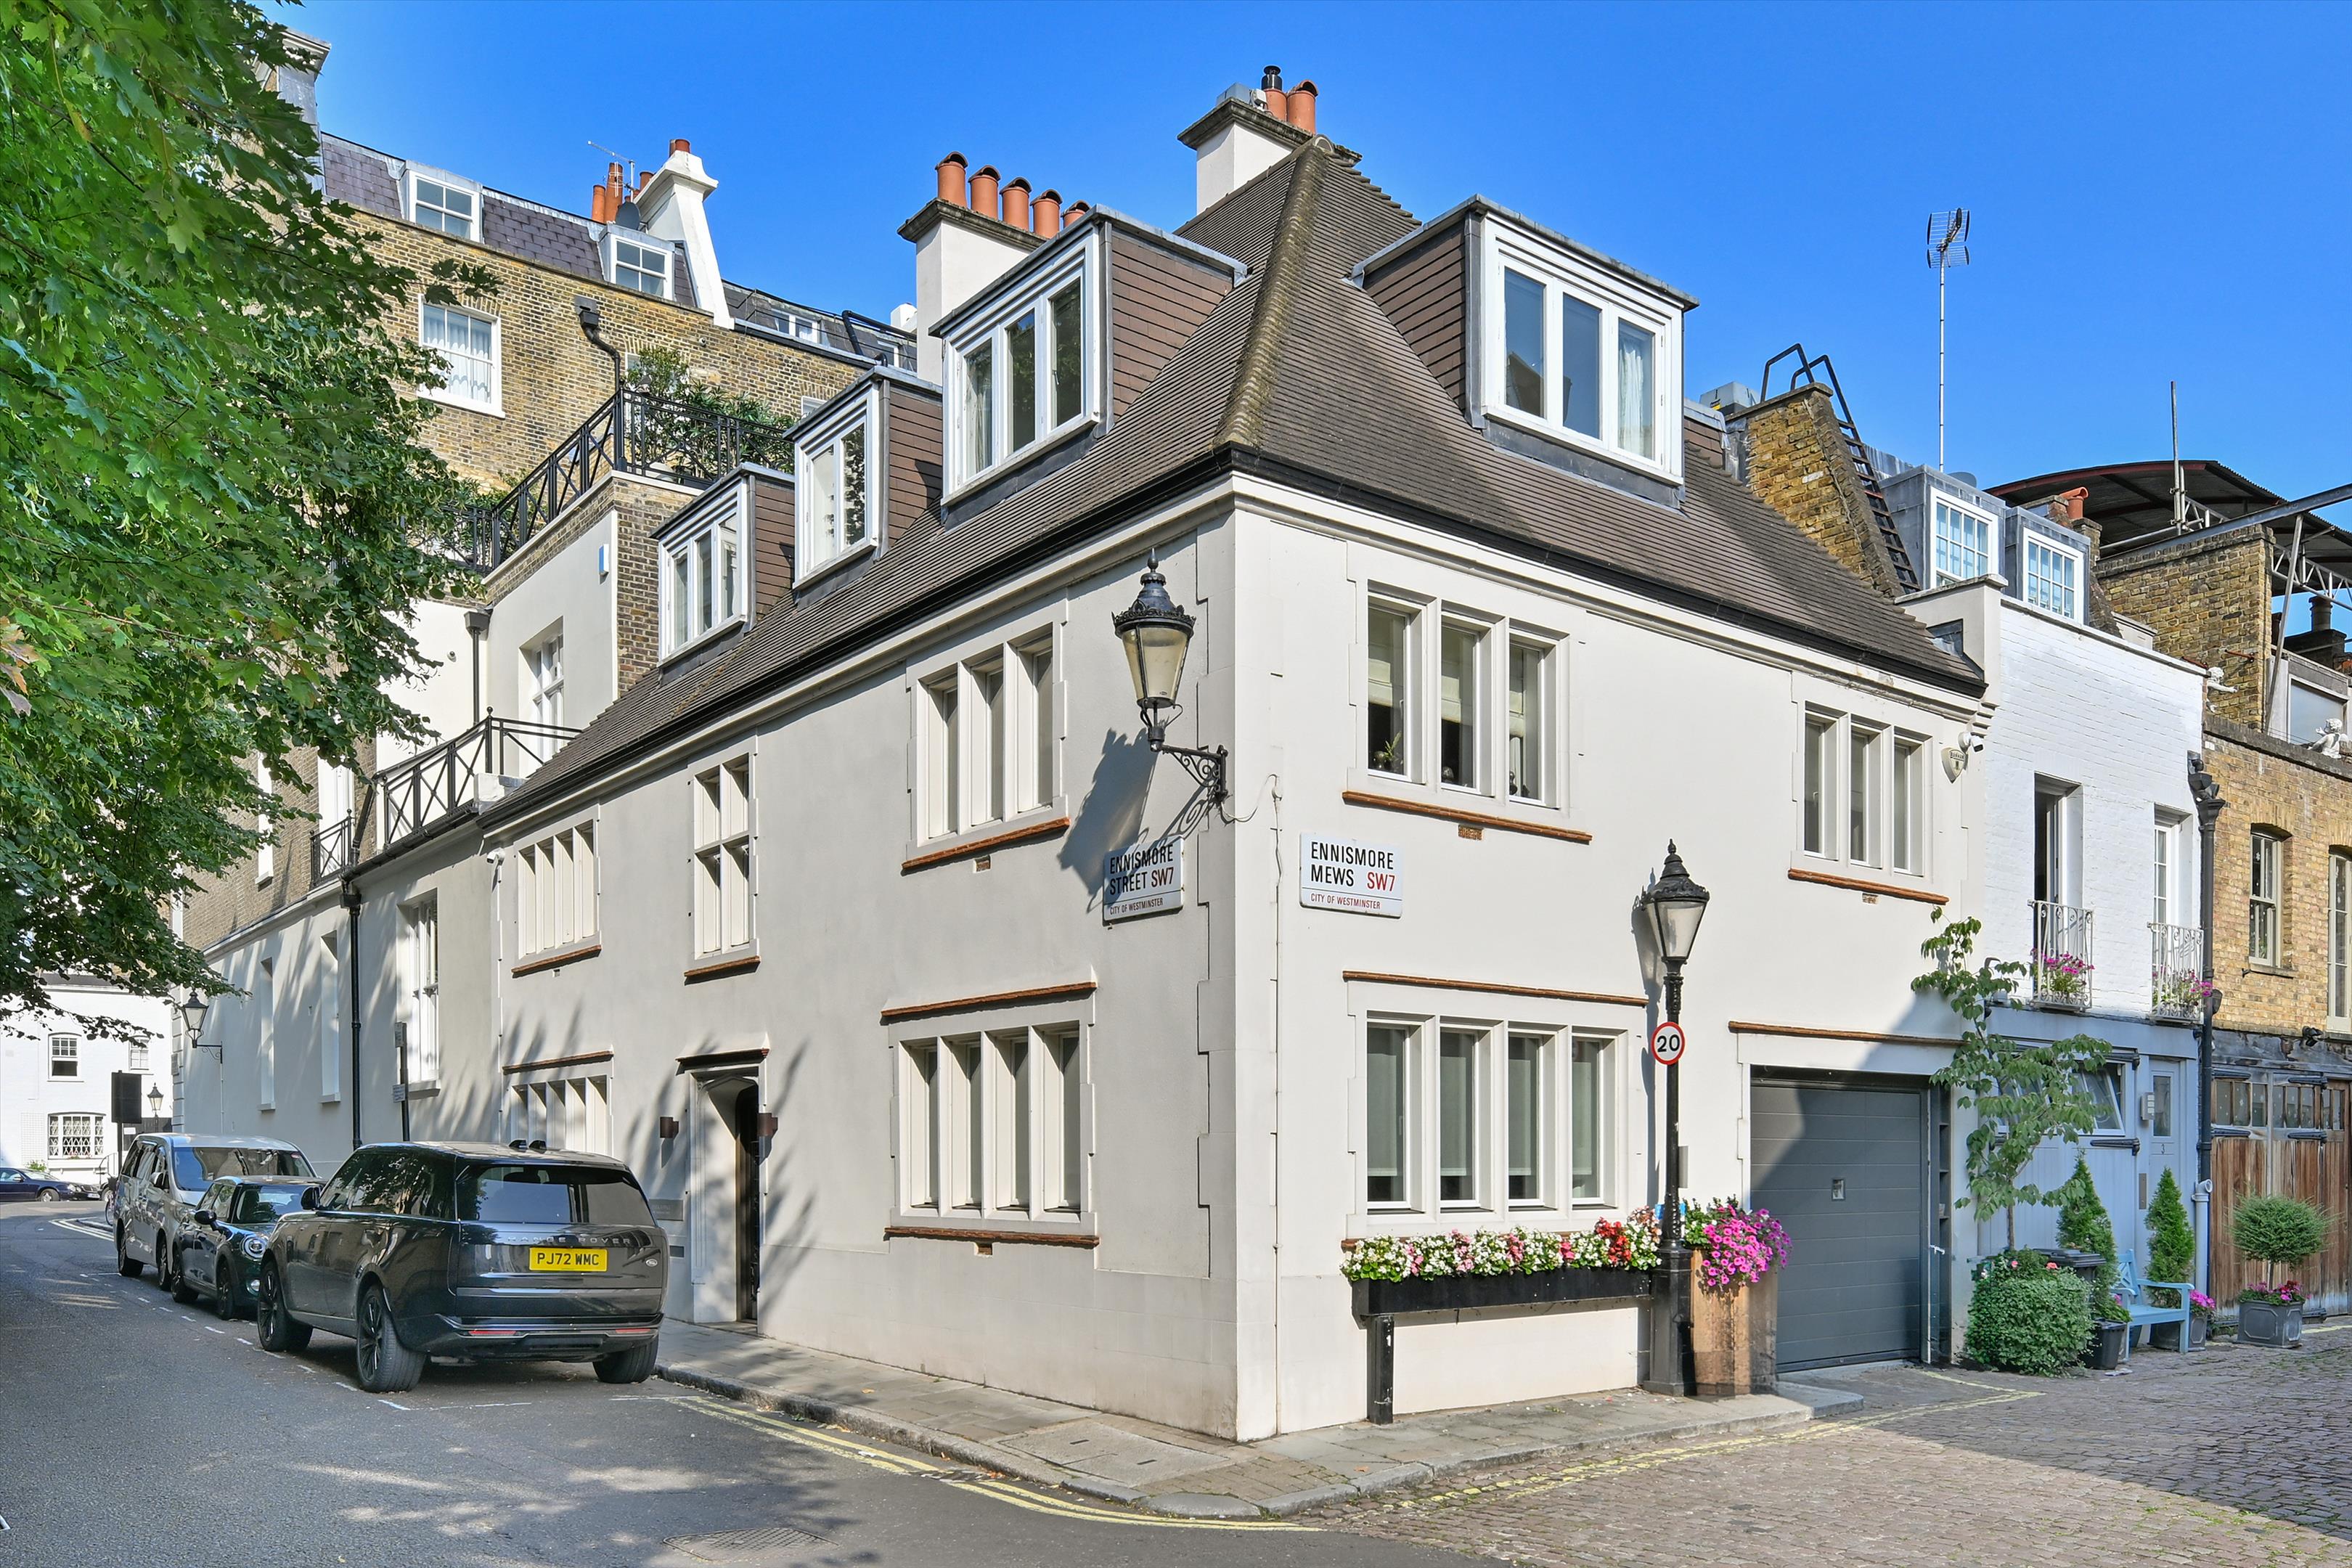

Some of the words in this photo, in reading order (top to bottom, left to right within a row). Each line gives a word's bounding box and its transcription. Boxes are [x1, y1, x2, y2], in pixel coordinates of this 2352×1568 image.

[1110, 844, 1173, 874] ENNISMORE
[1311, 841, 1394, 870] ENNISMORE
[1110, 872, 1148, 895] STREET
[1151, 867, 1174, 888] SW7
[1311, 864, 1354, 887] MEWS
[1367, 872, 1395, 891] SW7
[1110, 905, 1121, 915] CITY
[1122, 904, 1129, 913] OF
[1129, 898, 1164, 911] WESTMINSTER
[1311, 893, 1325, 902] CITY
[1327, 895, 1335, 904] OF
[1337, 897, 1381, 909] WESTMINSTER
[1657, 1034, 1681, 1052] 20
[537, 1252, 571, 1265] PJ72
[575, 1254, 599, 1265] WMC
